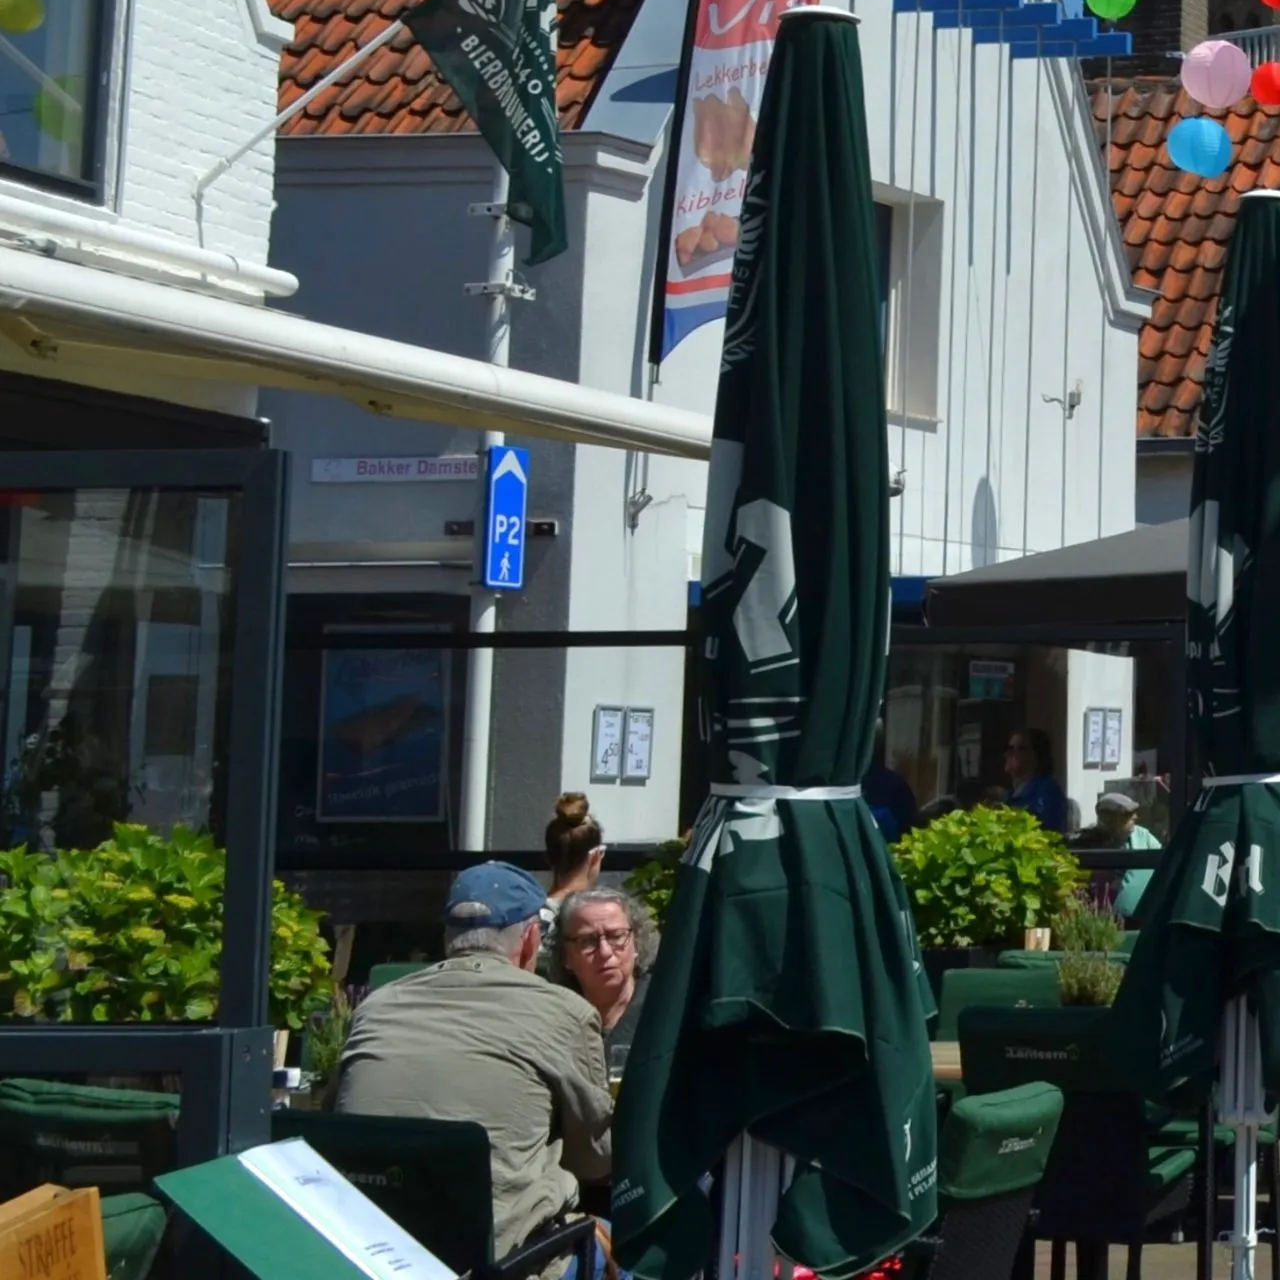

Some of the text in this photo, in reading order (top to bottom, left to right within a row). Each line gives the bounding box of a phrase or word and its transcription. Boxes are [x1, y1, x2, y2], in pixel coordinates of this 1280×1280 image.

[461, 34, 550, 163] BIERBROUWERIJ
[357, 460, 412, 476] Bakker
[495, 514, 521, 545] P2
